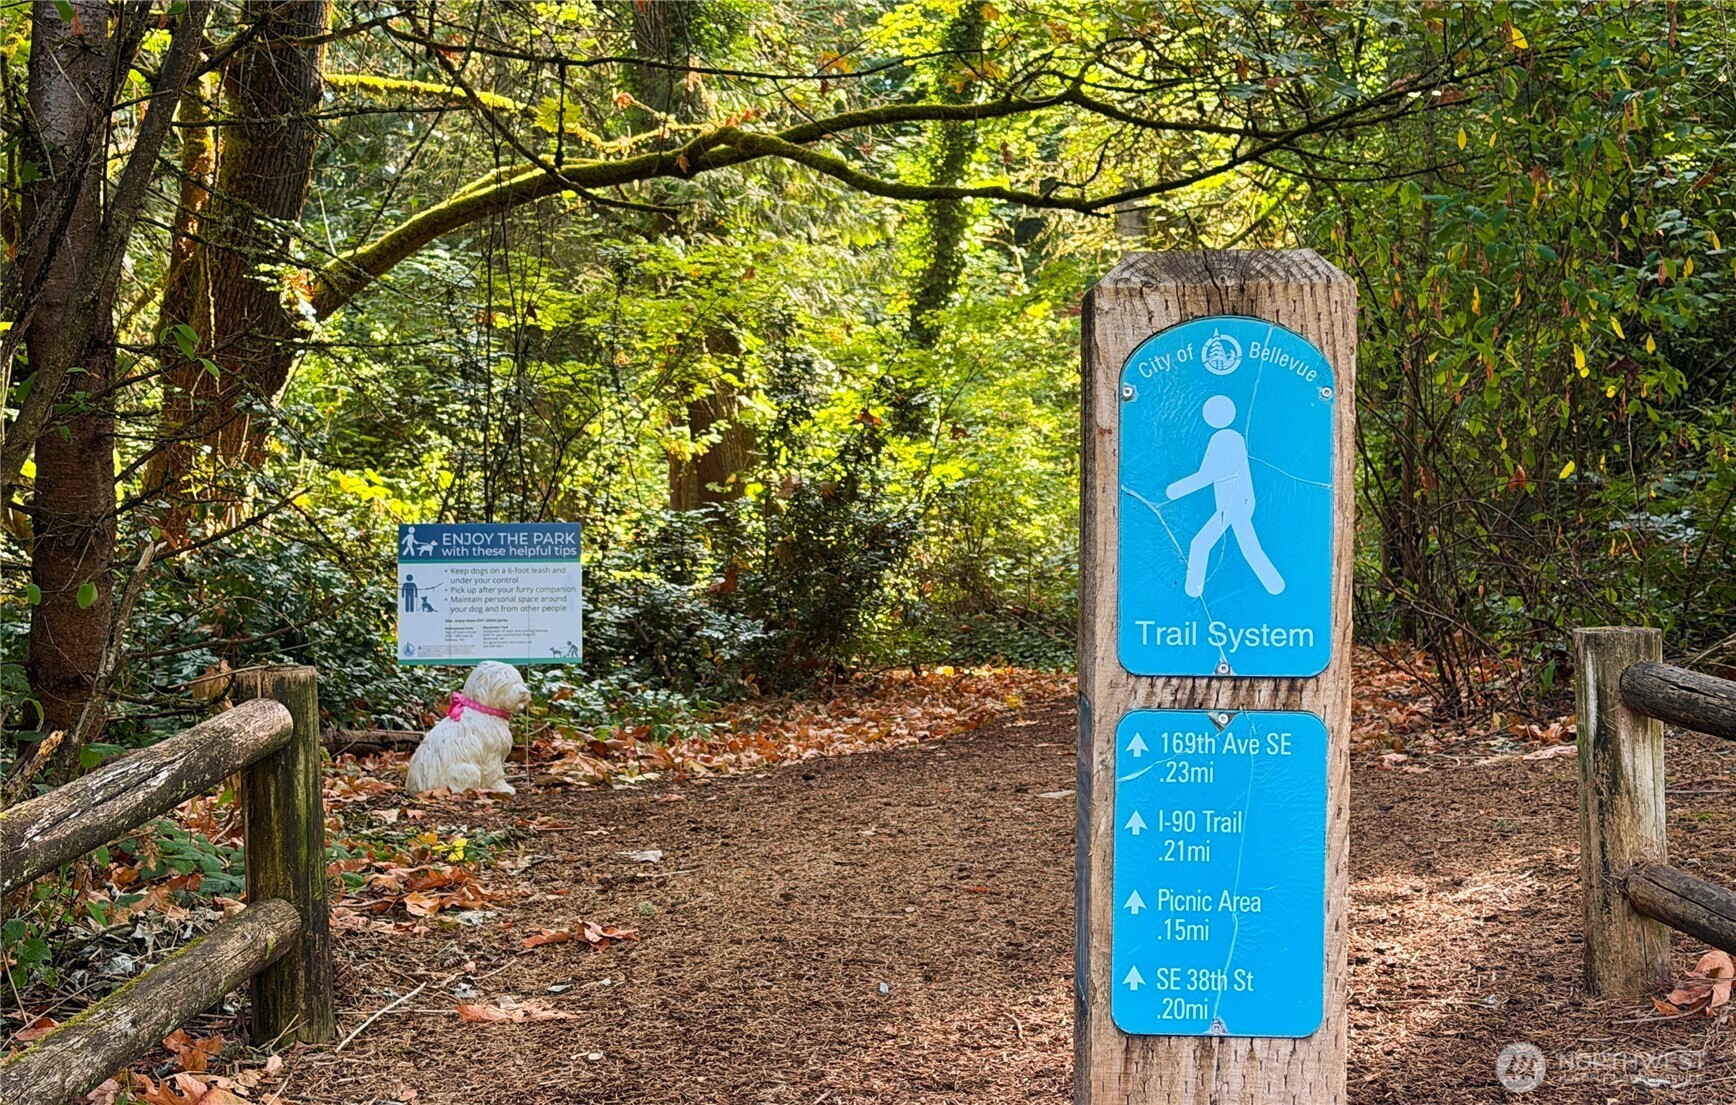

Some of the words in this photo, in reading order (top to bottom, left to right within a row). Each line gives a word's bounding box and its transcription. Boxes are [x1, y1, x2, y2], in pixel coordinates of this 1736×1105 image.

[1138, 350, 1173, 379] City
[1176, 344, 1194, 362] of
[1249, 341, 1317, 382] Bellevue
[442, 532, 494, 546] ENJOY
[497, 532, 528, 545] THE
[534, 532, 576, 545] PARK
[441, 546, 469, 556] with
[472, 546, 506, 556] these
[509, 546, 552, 558] helpful
[554, 546, 577, 558] tips
[471, 567, 488, 575] dogs
[485, 596, 516, 604] personal
[519, 596, 539, 604] space
[516, 586, 534, 594] furry
[536, 586, 576, 594] companion
[450, 606, 467, 614] your
[469, 606, 483, 614] dog
[542, 605, 566, 613] people
[1135, 621, 1197, 646] Trail
[1207, 621, 1314, 653] System
[1161, 732, 1216, 754] 169th
[1222, 732, 1260, 754] Ave
[1266, 732, 1292, 755] SE
[1159, 761, 1214, 783] .23mi
[1159, 810, 1196, 832] I-90
[1202, 810, 1242, 834] Trail
[1158, 840, 1210, 862] .21mi
[1158, 889, 1212, 912] Picnic
[1218, 890, 1262, 912] Area
[1157, 918, 1209, 941] .15mi
[1156, 968, 1180, 991] SE
[1186, 968, 1228, 991] 38th
[1233, 969, 1254, 992] St
[1156, 998, 1208, 1020] .20mi
